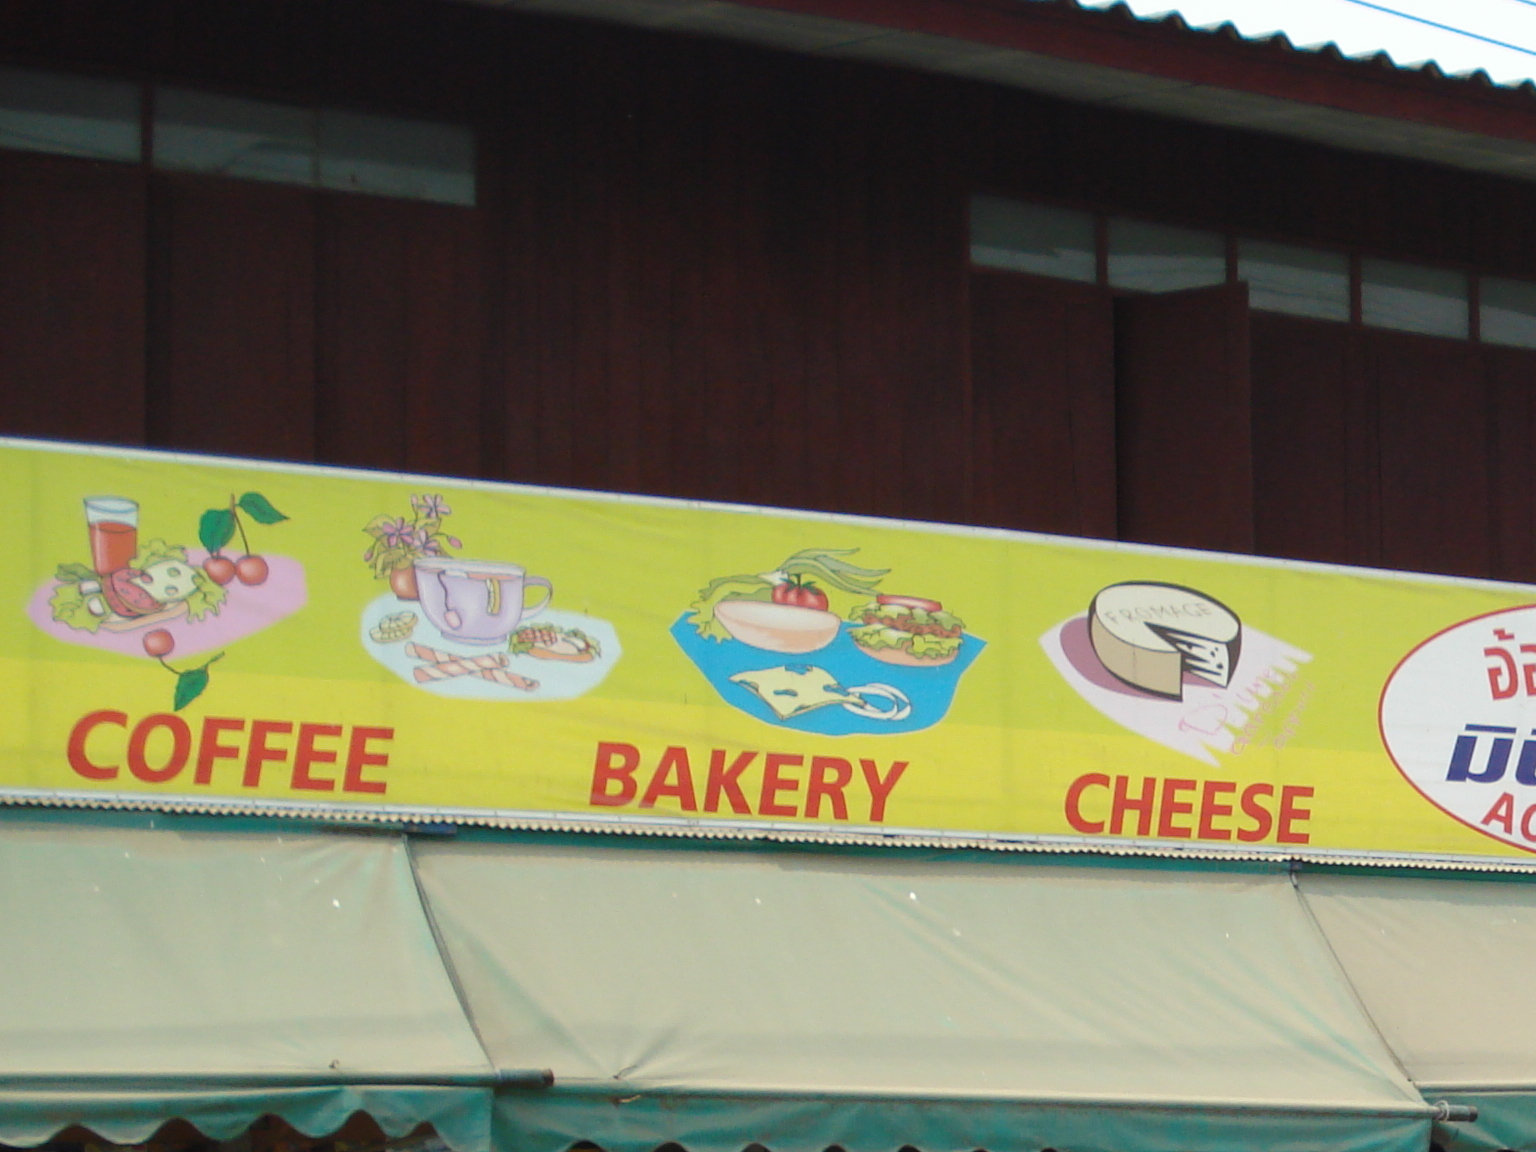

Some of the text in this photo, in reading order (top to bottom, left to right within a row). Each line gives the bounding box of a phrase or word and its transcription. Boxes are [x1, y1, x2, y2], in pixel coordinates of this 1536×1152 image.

[66, 709, 395, 794] COFFEE
[588, 741, 910, 823] BAKERY
[1064, 772, 1315, 845] CHEESE
